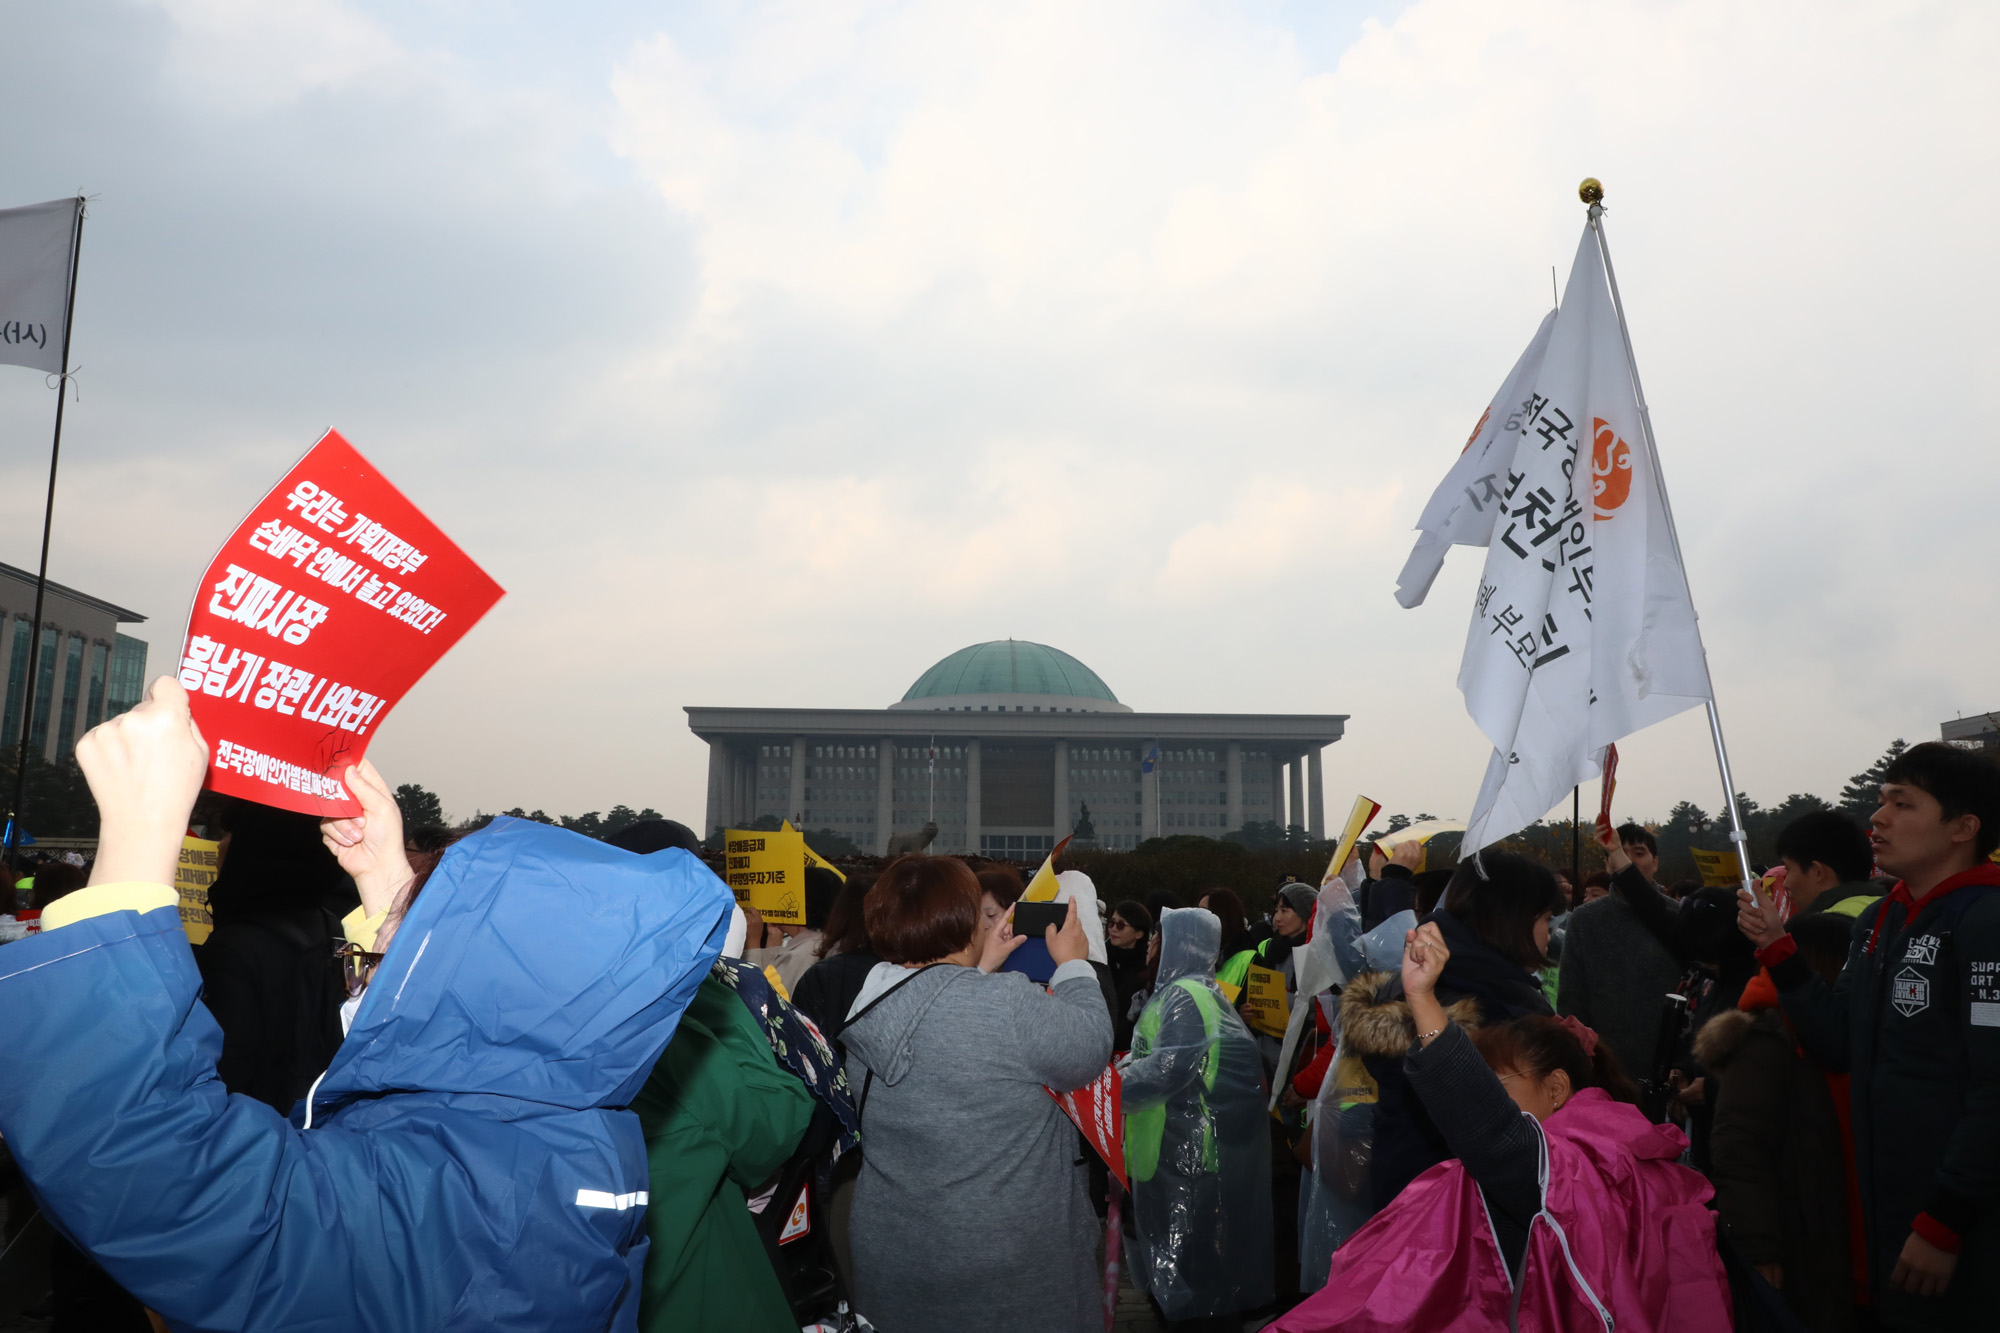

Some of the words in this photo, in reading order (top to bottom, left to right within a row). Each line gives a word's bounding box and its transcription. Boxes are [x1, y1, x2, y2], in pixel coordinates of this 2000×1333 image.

[286, 481, 348, 534] 우리는
[337, 513, 428, 575] 기획재정부
[209, 563, 330, 645] 진짜사장
[249, 519, 320, 568] 손바닥
[306, 547, 370, 593] 안에서
[356, 574, 401, 610] 놀고
[386, 591, 447, 634] 있었다!
[178, 634, 265, 703] 홍남기
[254, 661, 315, 715] 장관
[301, 678, 386, 735] 나와라!
[728, 838, 765, 853] #장애등급제
[729, 871, 786, 885] #부양의무자기준
[1970, 975, 1994, 986] ORT
